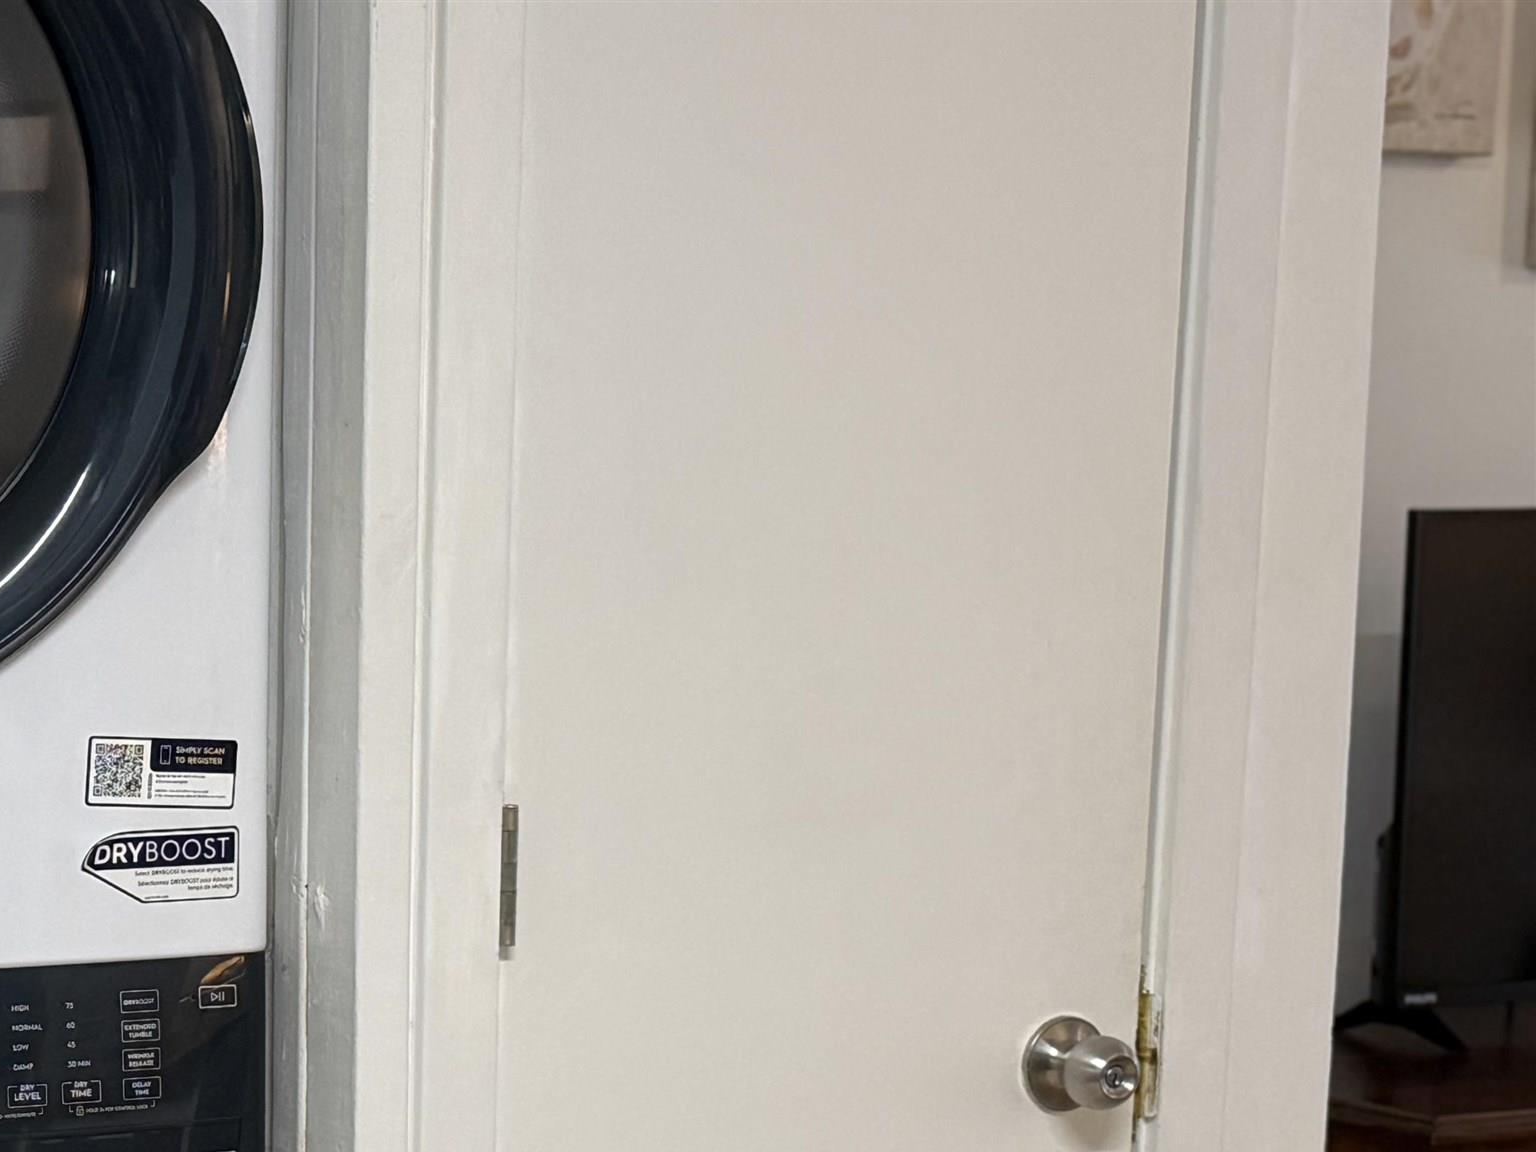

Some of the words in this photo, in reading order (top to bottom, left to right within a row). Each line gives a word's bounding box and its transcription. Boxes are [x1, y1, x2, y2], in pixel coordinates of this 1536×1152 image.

[175, 745, 203, 754] SIMPLY
[204, 746, 225, 755] SCAN
[175, 756, 185, 764] TO
[187, 757, 223, 765] REGISTER
[94, 837, 230, 865] DRYBOOST
[11, 1004, 30, 1012] HIGH
[11, 1023, 43, 1032] NORMAL
[124, 1023, 157, 1031] EXTENDED
[12, 1043, 30, 1052] LOW
[13, 1062, 34, 1071] DAMP
[20, 1084, 35, 1092] DRY
[74, 1080, 88, 1088] DRY
[14, 1091, 42, 1101] LEVEL
[70, 1088, 92, 1098] TIME
